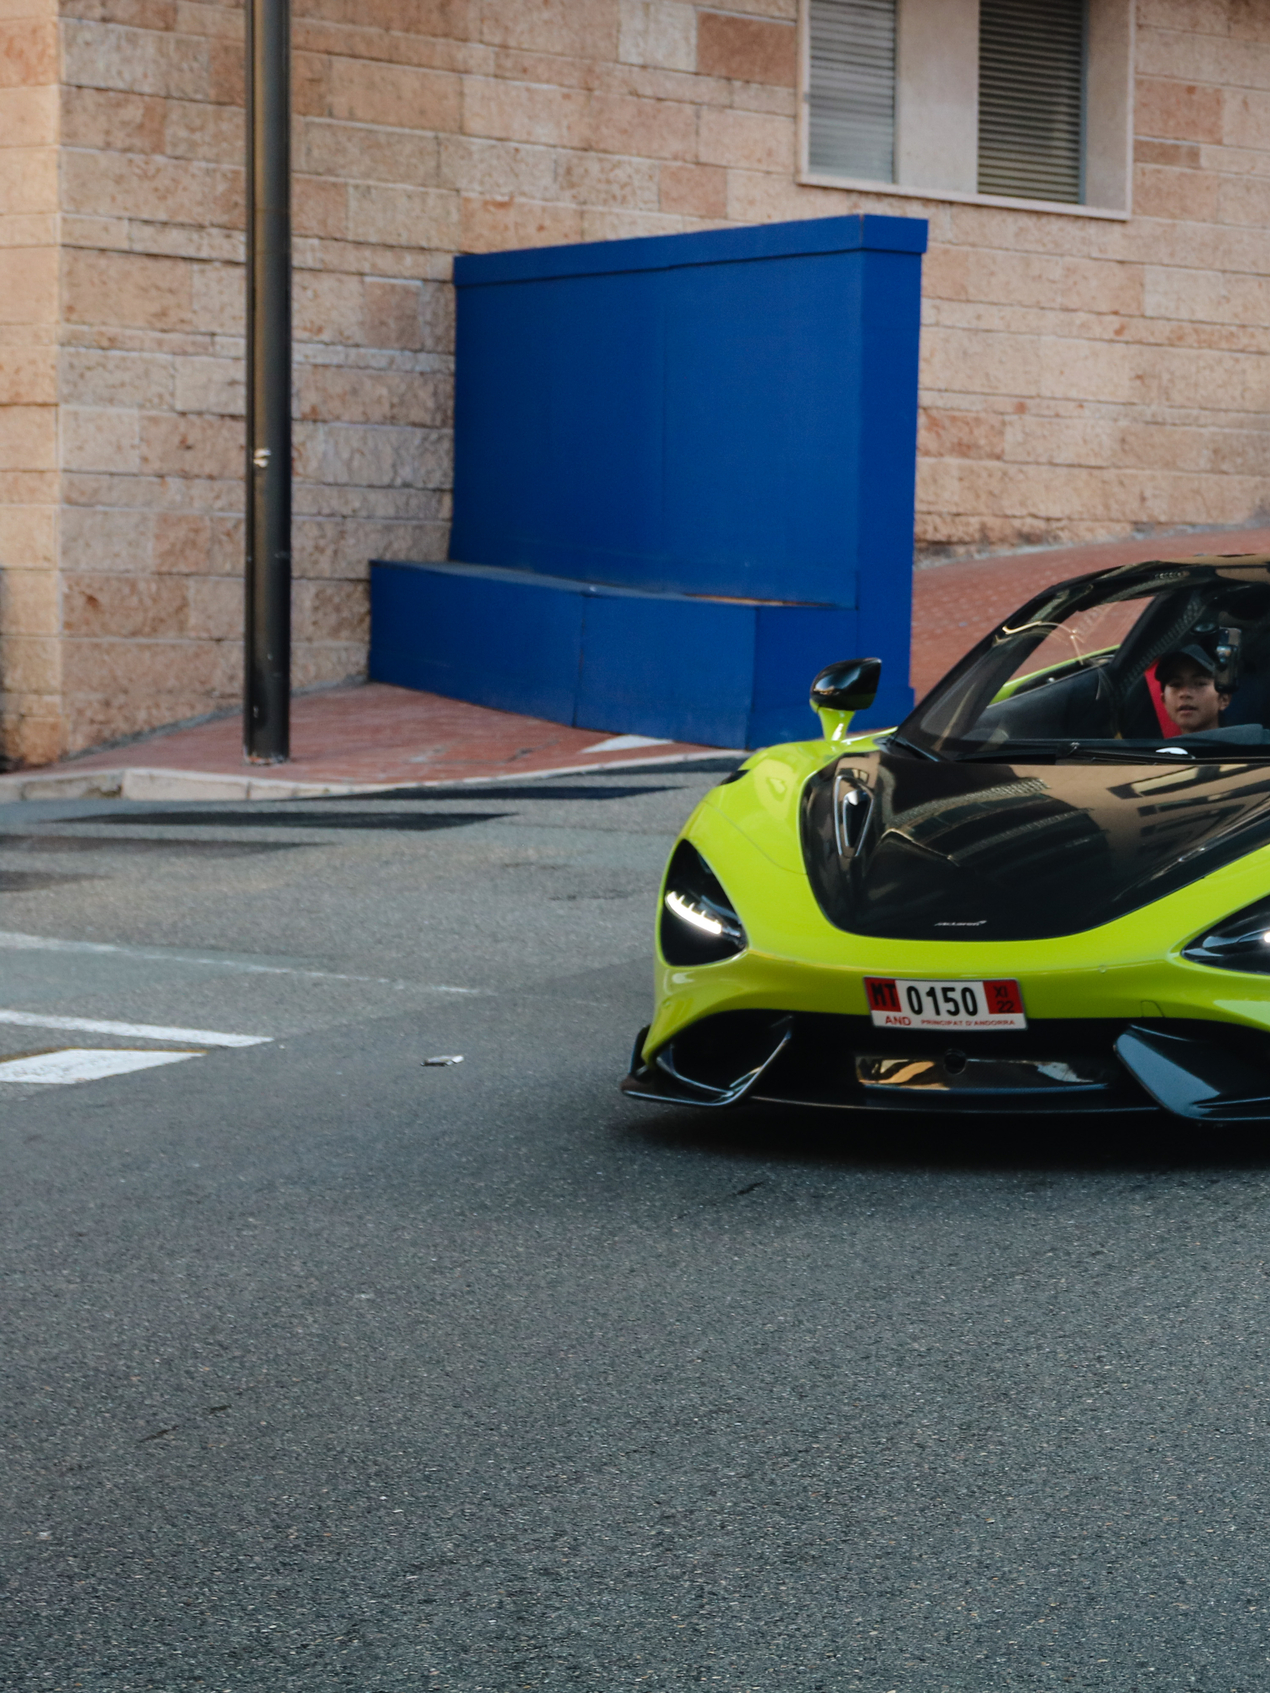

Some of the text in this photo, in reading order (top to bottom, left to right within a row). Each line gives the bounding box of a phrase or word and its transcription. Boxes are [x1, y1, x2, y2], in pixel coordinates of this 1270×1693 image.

[993, 985, 1008, 999] XI
[871, 983, 978, 1016] MT 0150
[997, 1001, 1015, 1013] 22
[885, 1015, 912, 1026] AND
